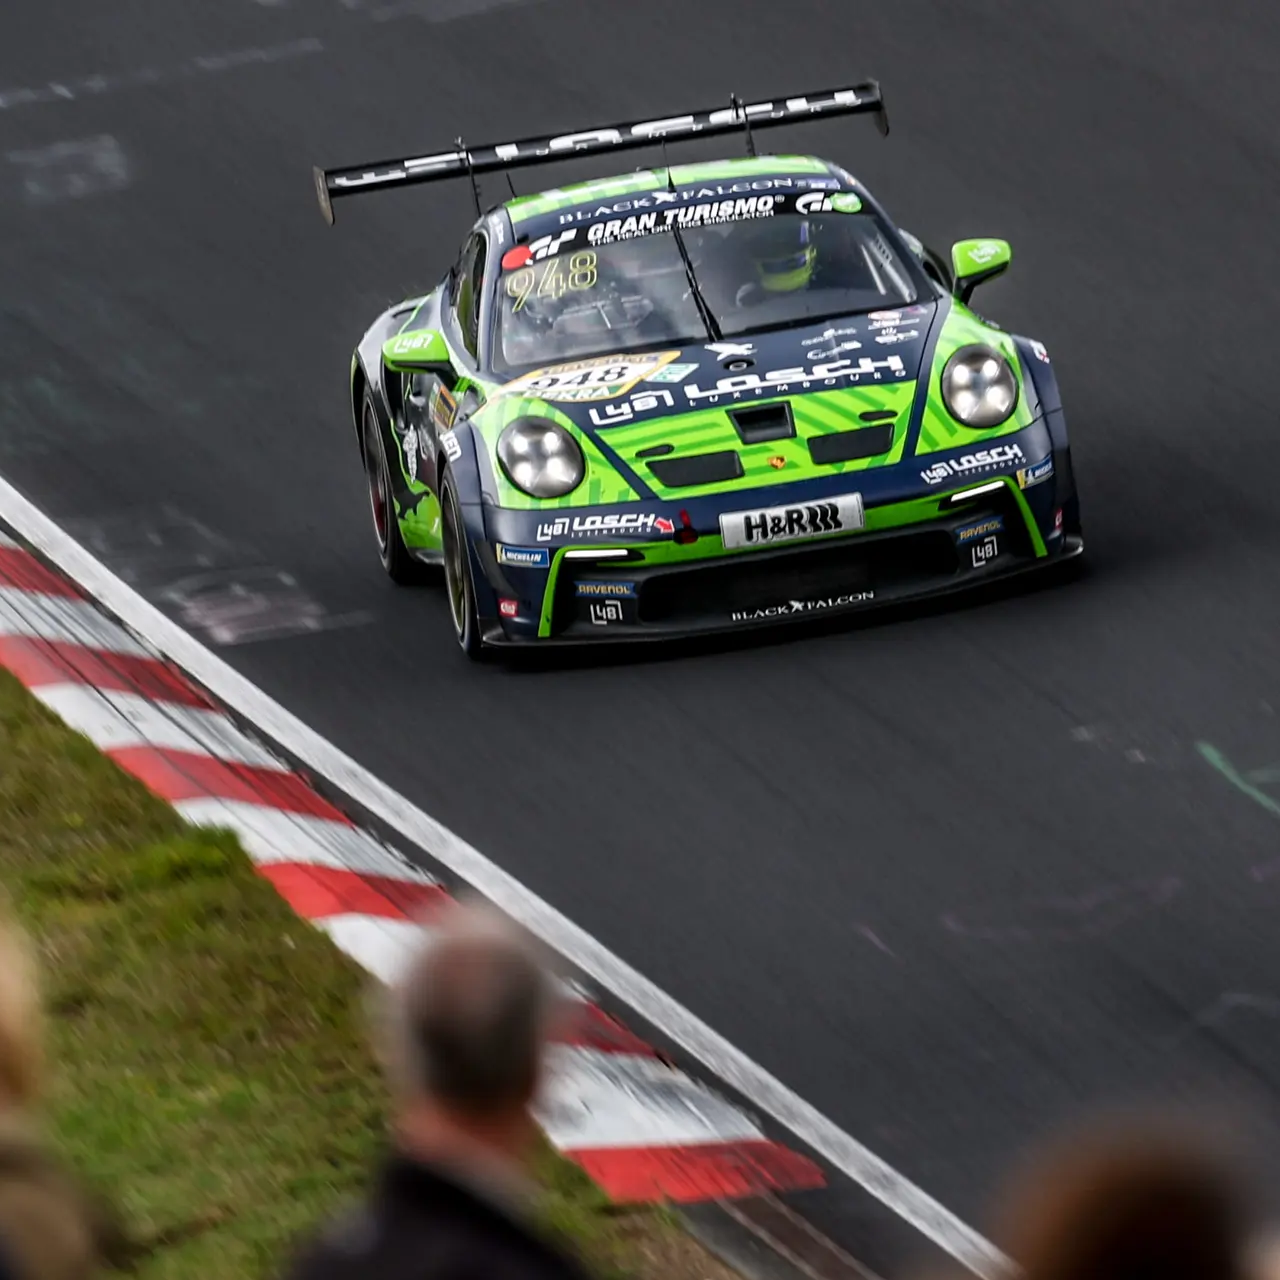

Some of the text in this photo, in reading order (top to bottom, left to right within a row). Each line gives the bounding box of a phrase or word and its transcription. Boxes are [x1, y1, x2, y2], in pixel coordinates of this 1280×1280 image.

[559, 198, 651, 225] BLACK
[682, 177, 792, 201] FALCON
[587, 211, 657, 242] GRAN
[505, 251, 598, 313] 948
[529, 366, 629, 390] 948
[684, 355, 904, 400] LOSCH
[950, 443, 1023, 471] LOSCH
[572, 514, 656, 531] LOSCH
[959, 521, 1001, 541] RAVENOL
[506, 550, 542, 562] MICHELIN
[577, 583, 632, 595] RAVENOL
[731, 590, 874, 621] BLACK FALCON
